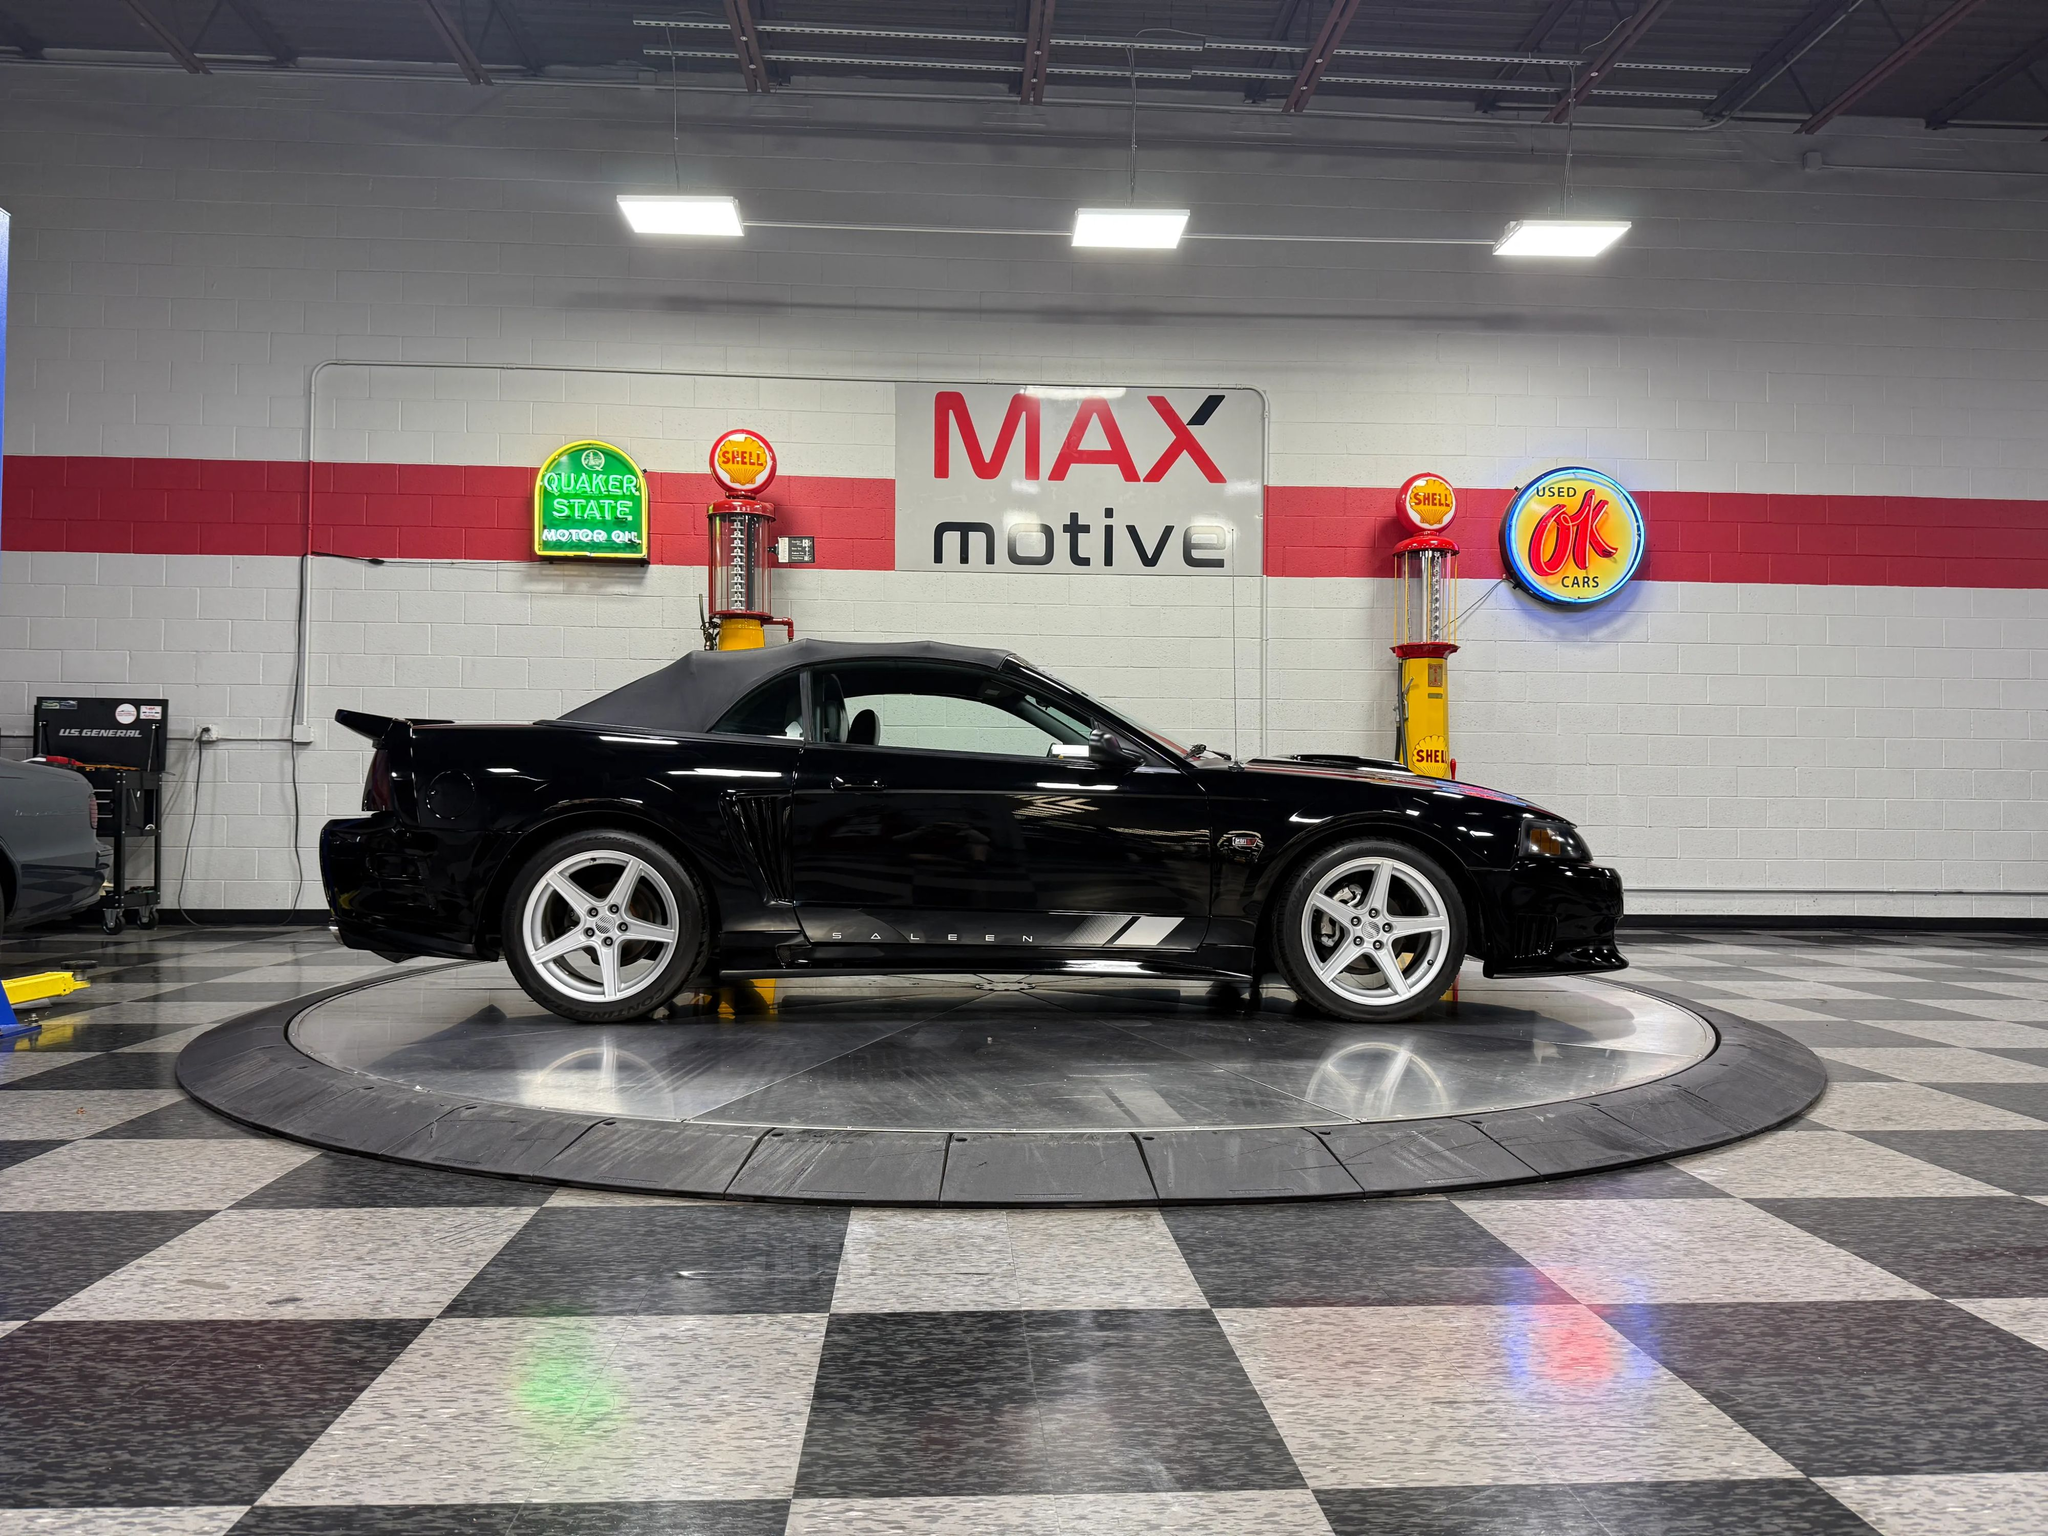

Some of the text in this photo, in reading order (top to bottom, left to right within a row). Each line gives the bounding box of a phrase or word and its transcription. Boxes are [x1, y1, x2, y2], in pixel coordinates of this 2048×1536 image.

[934, 391, 1227, 484] MAX
[721, 450, 764, 467] SHELL
[544, 472, 640, 496] QUAKER
[1413, 492, 1451, 508] SHELL
[1535, 486, 1577, 499] USED
[552, 498, 634, 521] STATE
[542, 528, 642, 543] MOTOR OIL
[933, 507, 1225, 568] motive
[1528, 489, 1619, 577] OK
[1561, 576, 1600, 589] CARS
[81, 729, 143, 738] GENERAL
[832, 932, 1033, 942] SALEEN
